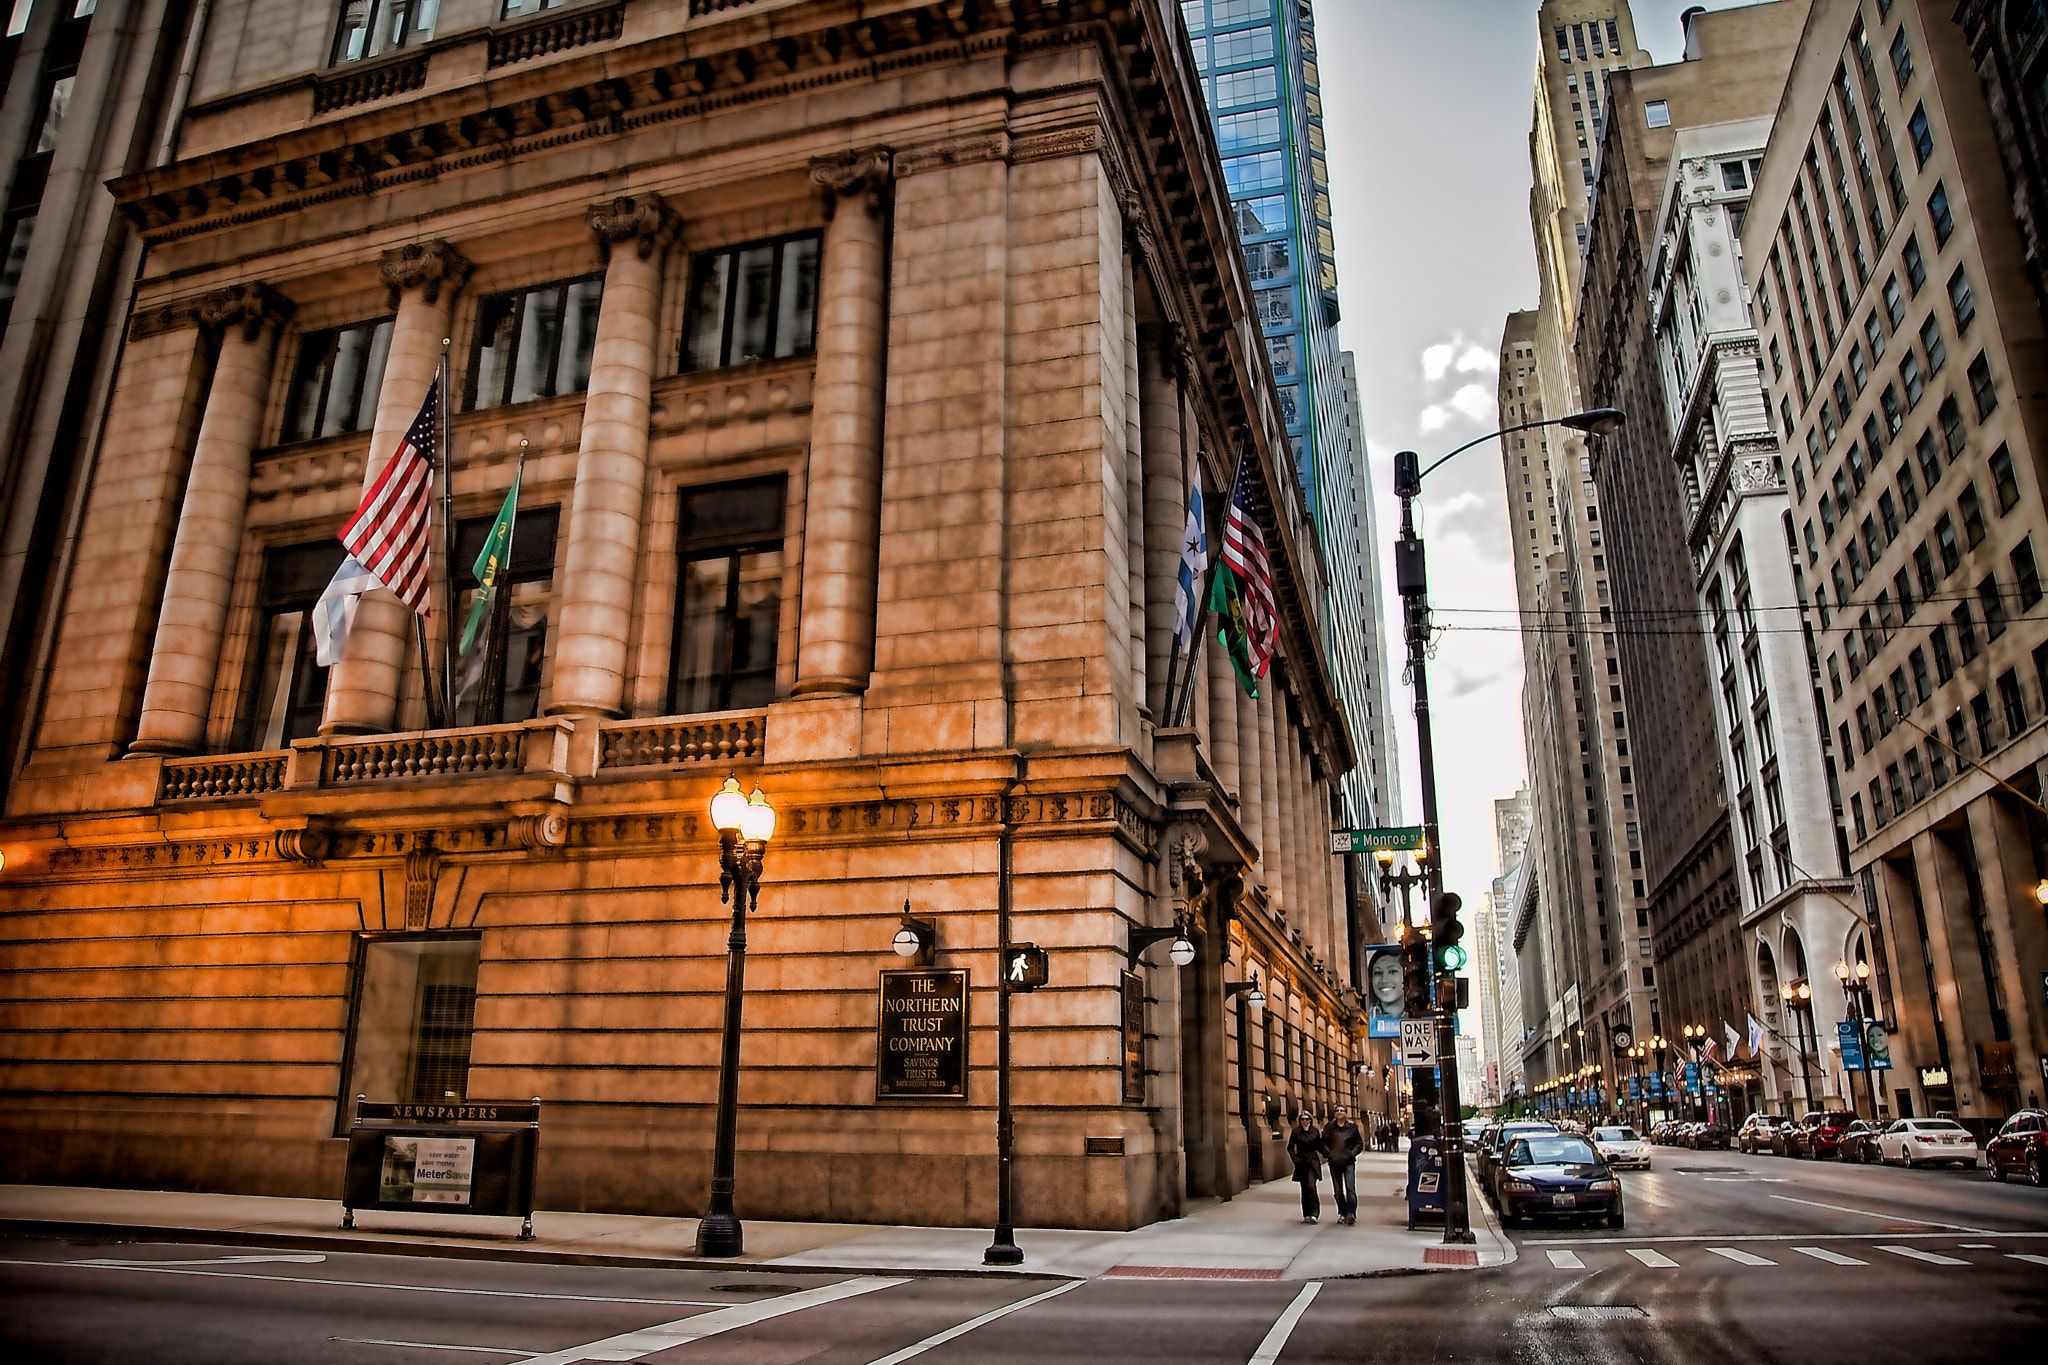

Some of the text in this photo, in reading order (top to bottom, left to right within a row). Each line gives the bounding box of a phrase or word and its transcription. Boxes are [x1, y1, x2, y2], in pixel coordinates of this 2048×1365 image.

[1363, 833, 1407, 847] Monroe
[1410, 834, 1419, 842] St
[910, 979, 936, 993] THE
[886, 997, 960, 1013] NORTHERN
[901, 1017, 944, 1032] TRUST
[1404, 1023, 1431, 1035] ONE
[889, 1037, 955, 1052] COMPANY
[1404, 1036, 1432, 1048] WAY
[903, 1058, 939, 1068] SAVINGS
[904, 1069, 938, 1079] TRUSTS
[393, 1105, 497, 1119] NEWSPAPERS
[416, 1168, 470, 1180] MeterSave
